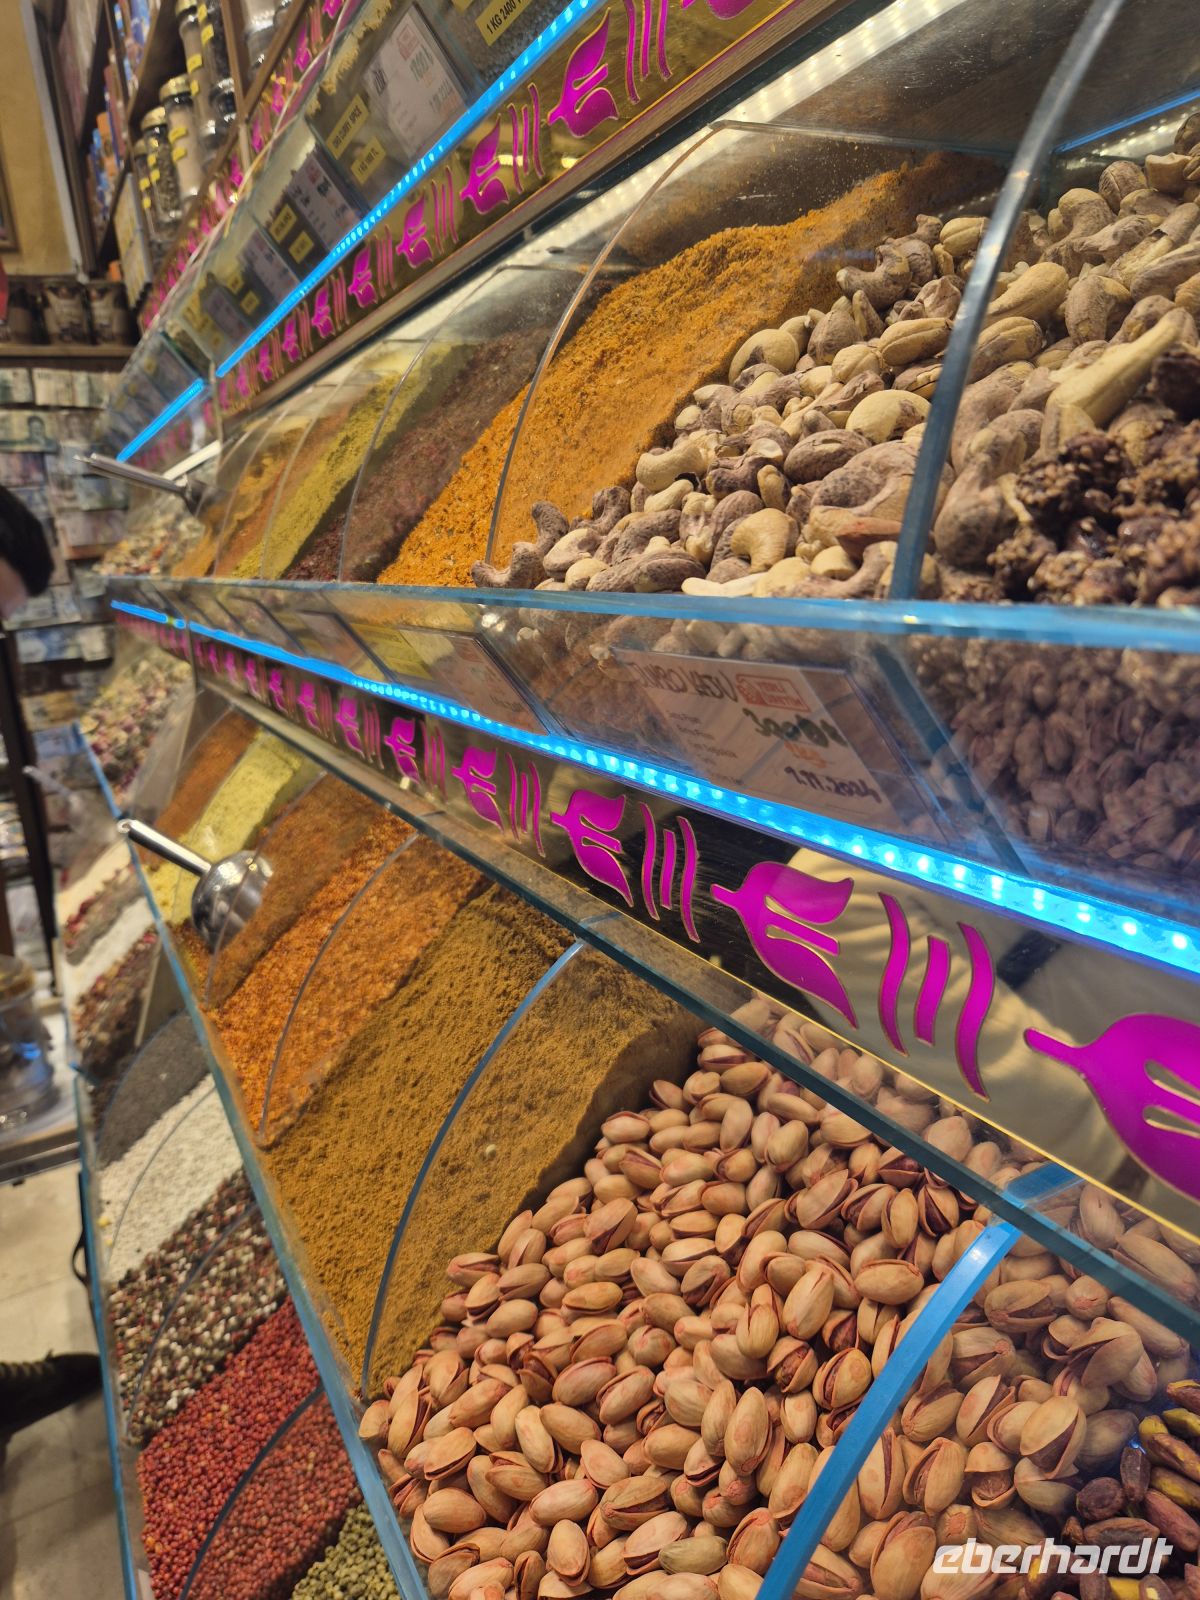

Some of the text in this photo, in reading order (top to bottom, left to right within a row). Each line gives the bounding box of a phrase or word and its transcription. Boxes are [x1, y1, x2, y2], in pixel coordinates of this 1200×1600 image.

[485, 0, 517, 35] 1 KG 2400
